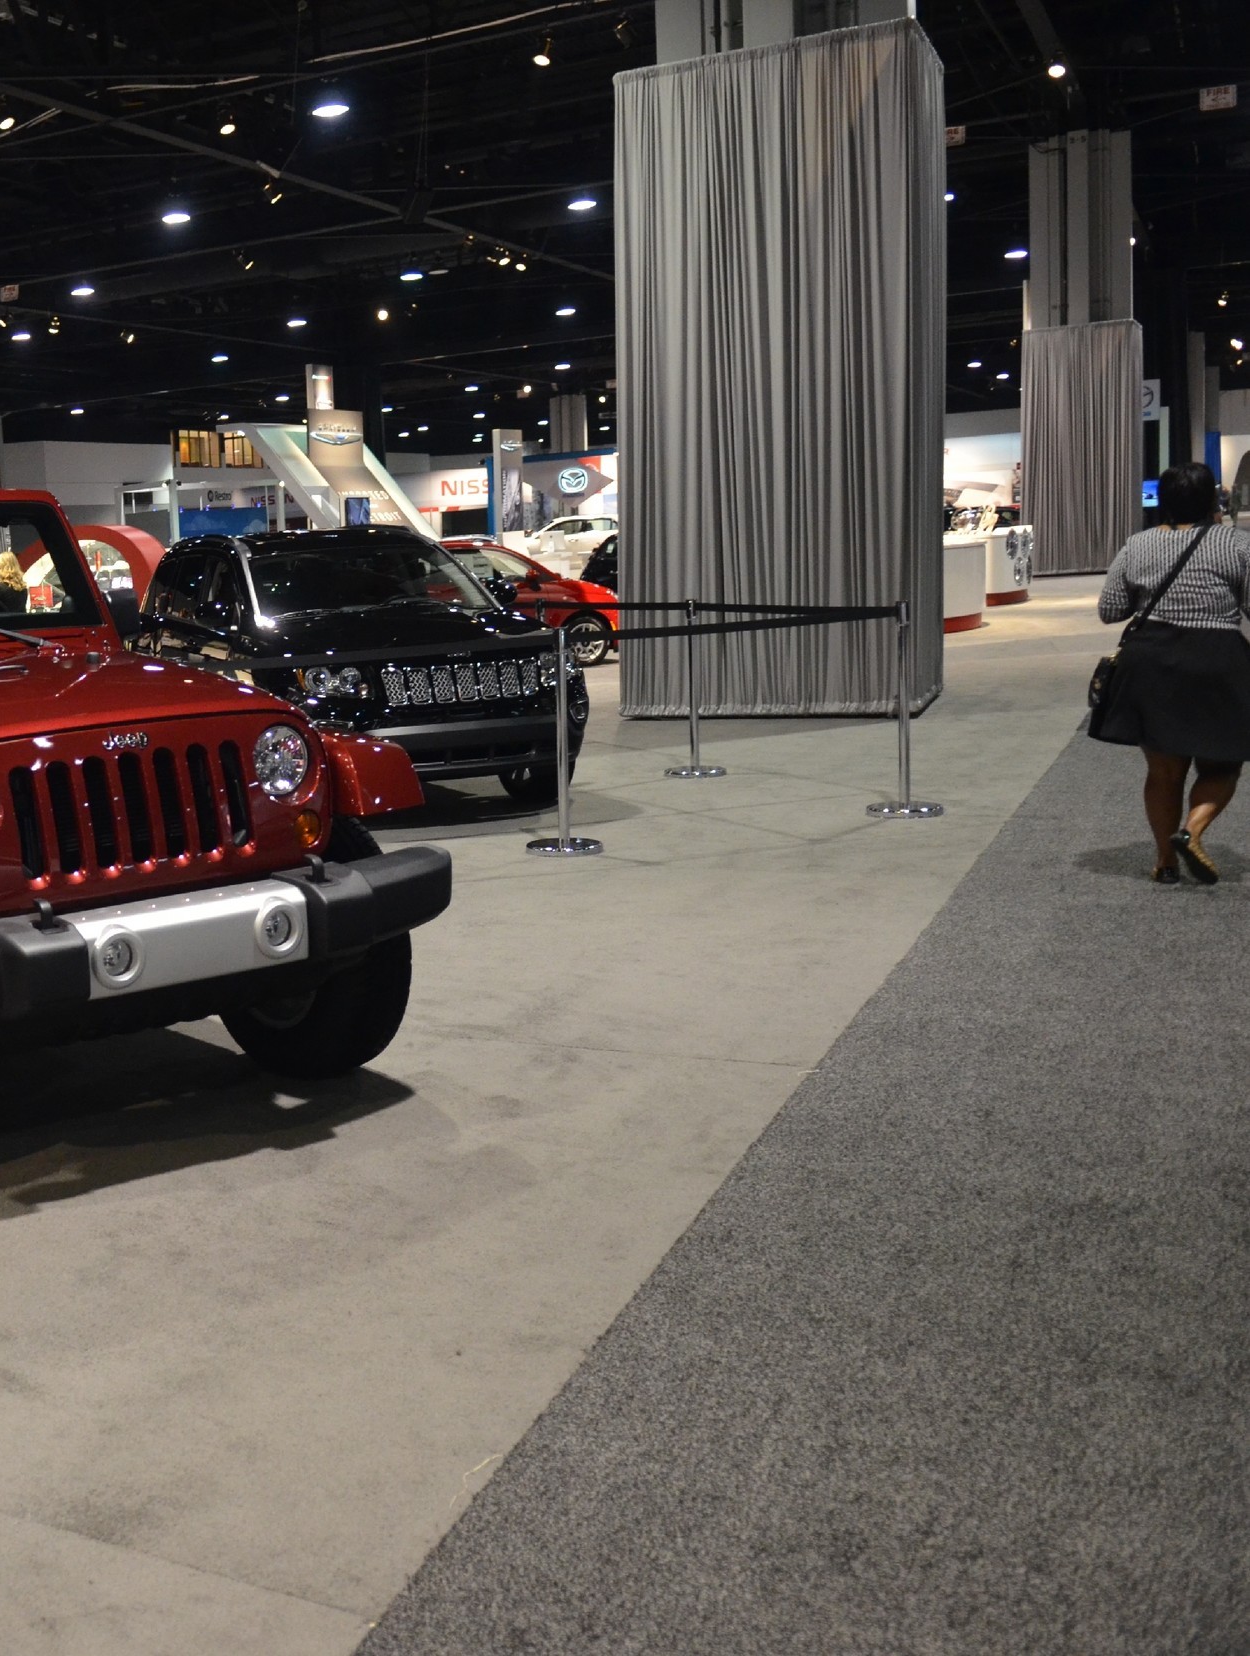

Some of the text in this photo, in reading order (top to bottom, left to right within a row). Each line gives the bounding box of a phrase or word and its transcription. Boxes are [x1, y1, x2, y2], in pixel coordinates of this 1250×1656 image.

[1206, 86, 1231, 96] FIRE
[250, 494, 294, 508] NISSN
[102, 731, 148, 750] Jeep
